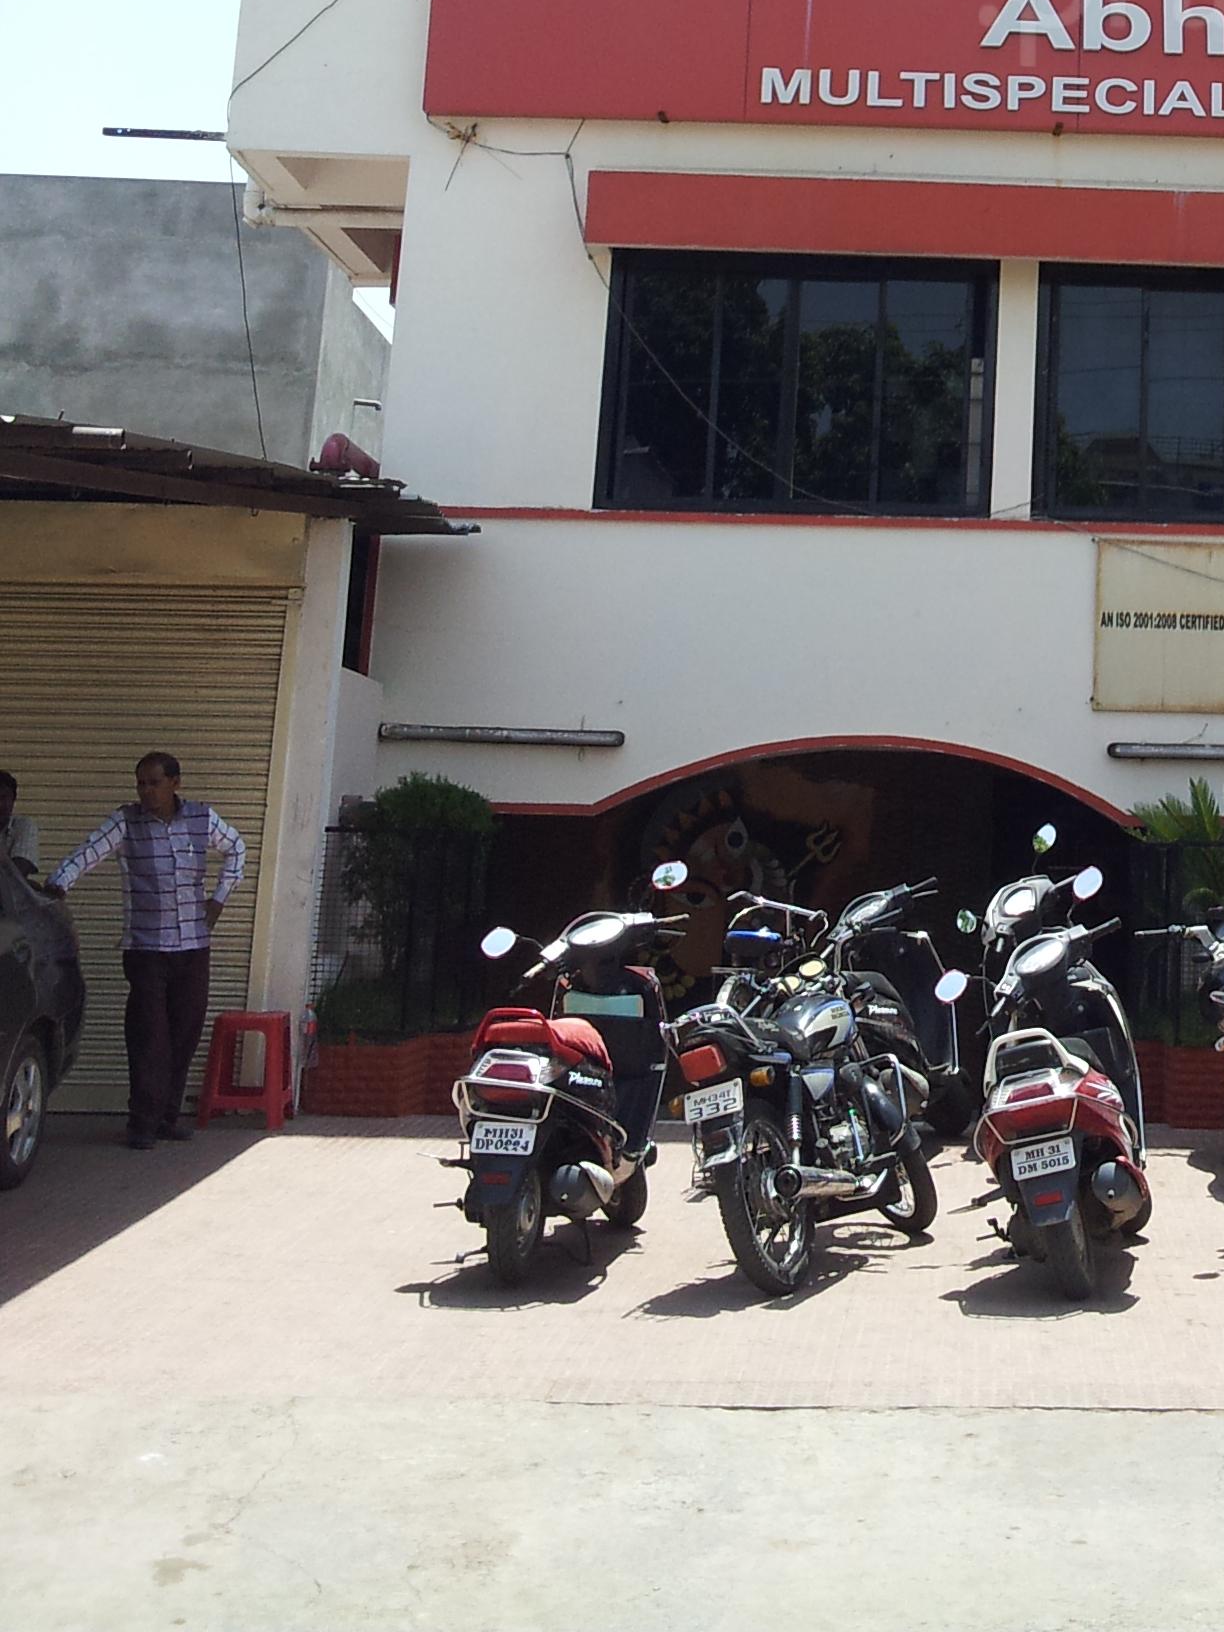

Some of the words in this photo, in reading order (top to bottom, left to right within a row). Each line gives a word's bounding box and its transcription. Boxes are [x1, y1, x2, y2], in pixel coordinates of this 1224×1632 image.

[1100, 611, 1114, 628] AN
[1115, 611, 1131, 629] ISO
[689, 1097, 738, 1122] 332
[1040, 1155, 1070, 1170] 5015
